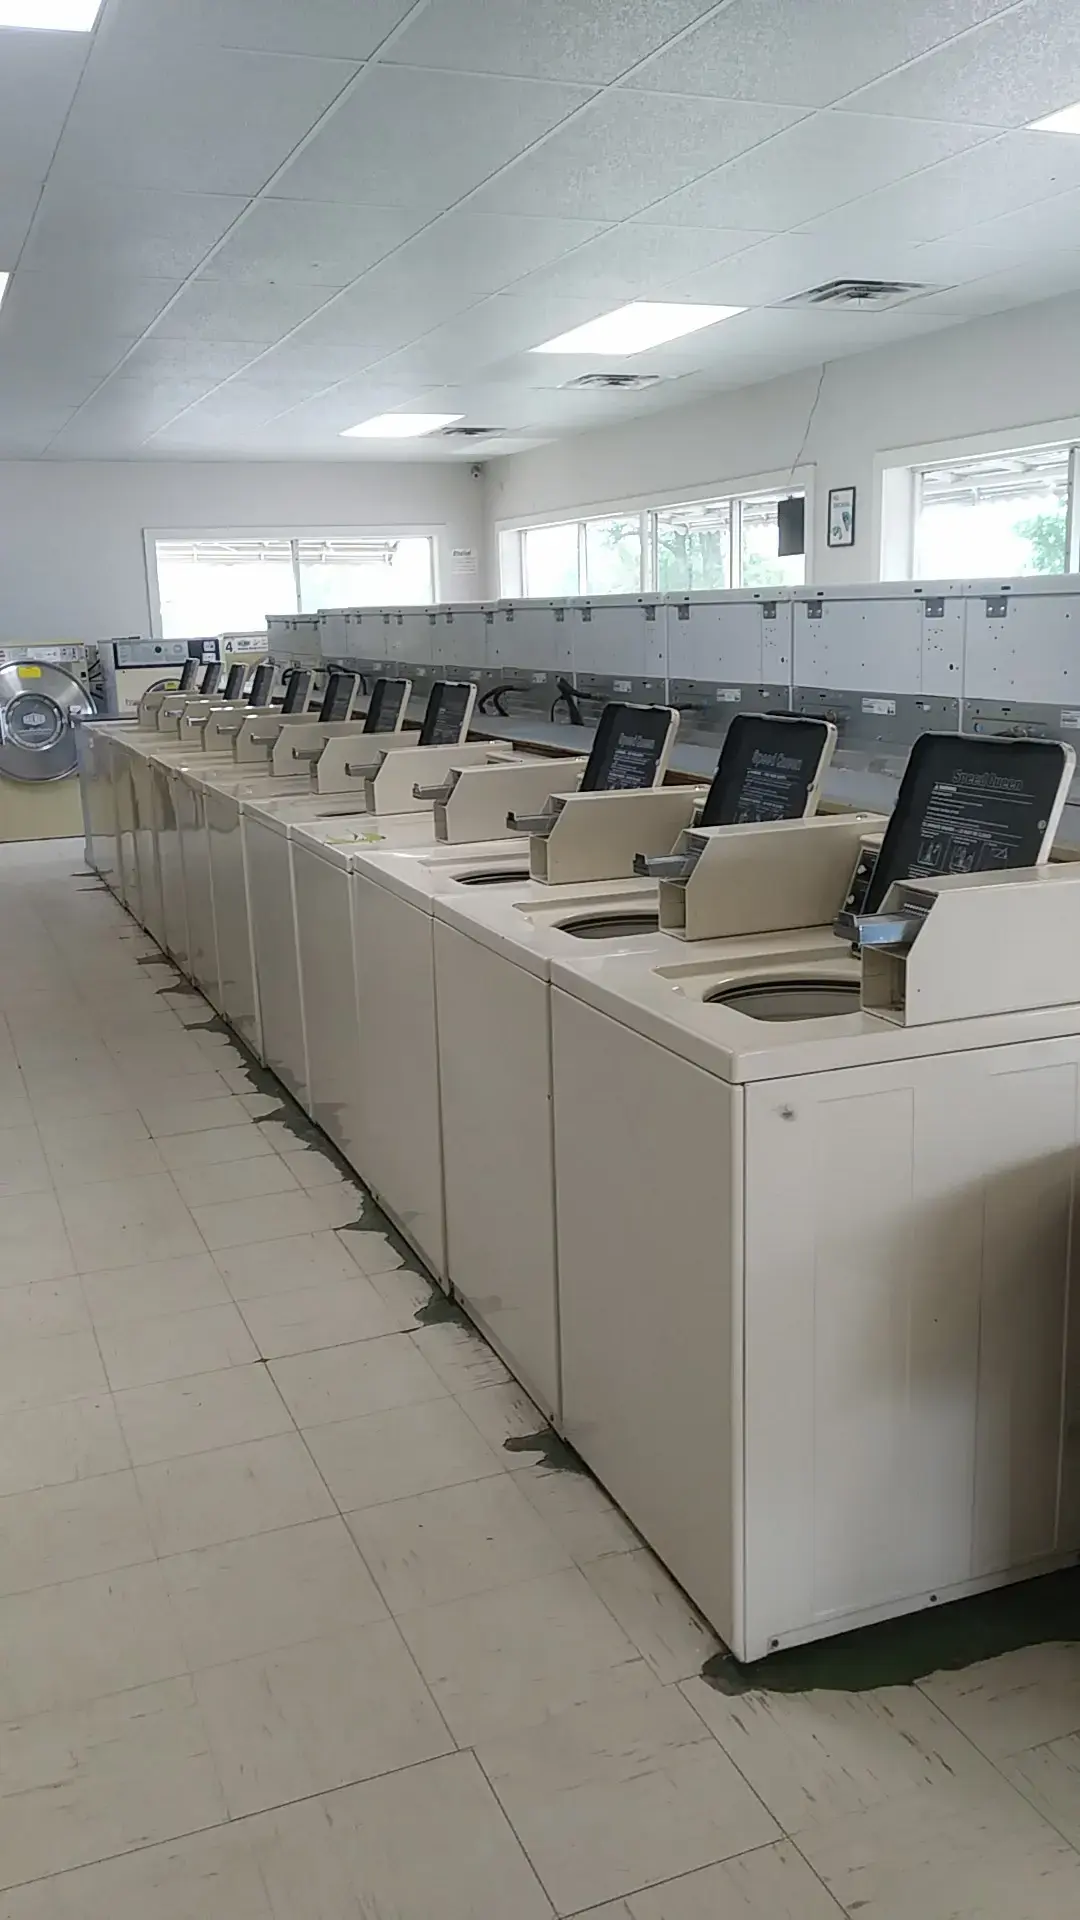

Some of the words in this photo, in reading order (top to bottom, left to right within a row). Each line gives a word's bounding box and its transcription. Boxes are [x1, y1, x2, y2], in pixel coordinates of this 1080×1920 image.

[225, 641, 233, 652] 4
[953, 768, 989, 787] Speed
[989, 772, 1023, 791] Queen
